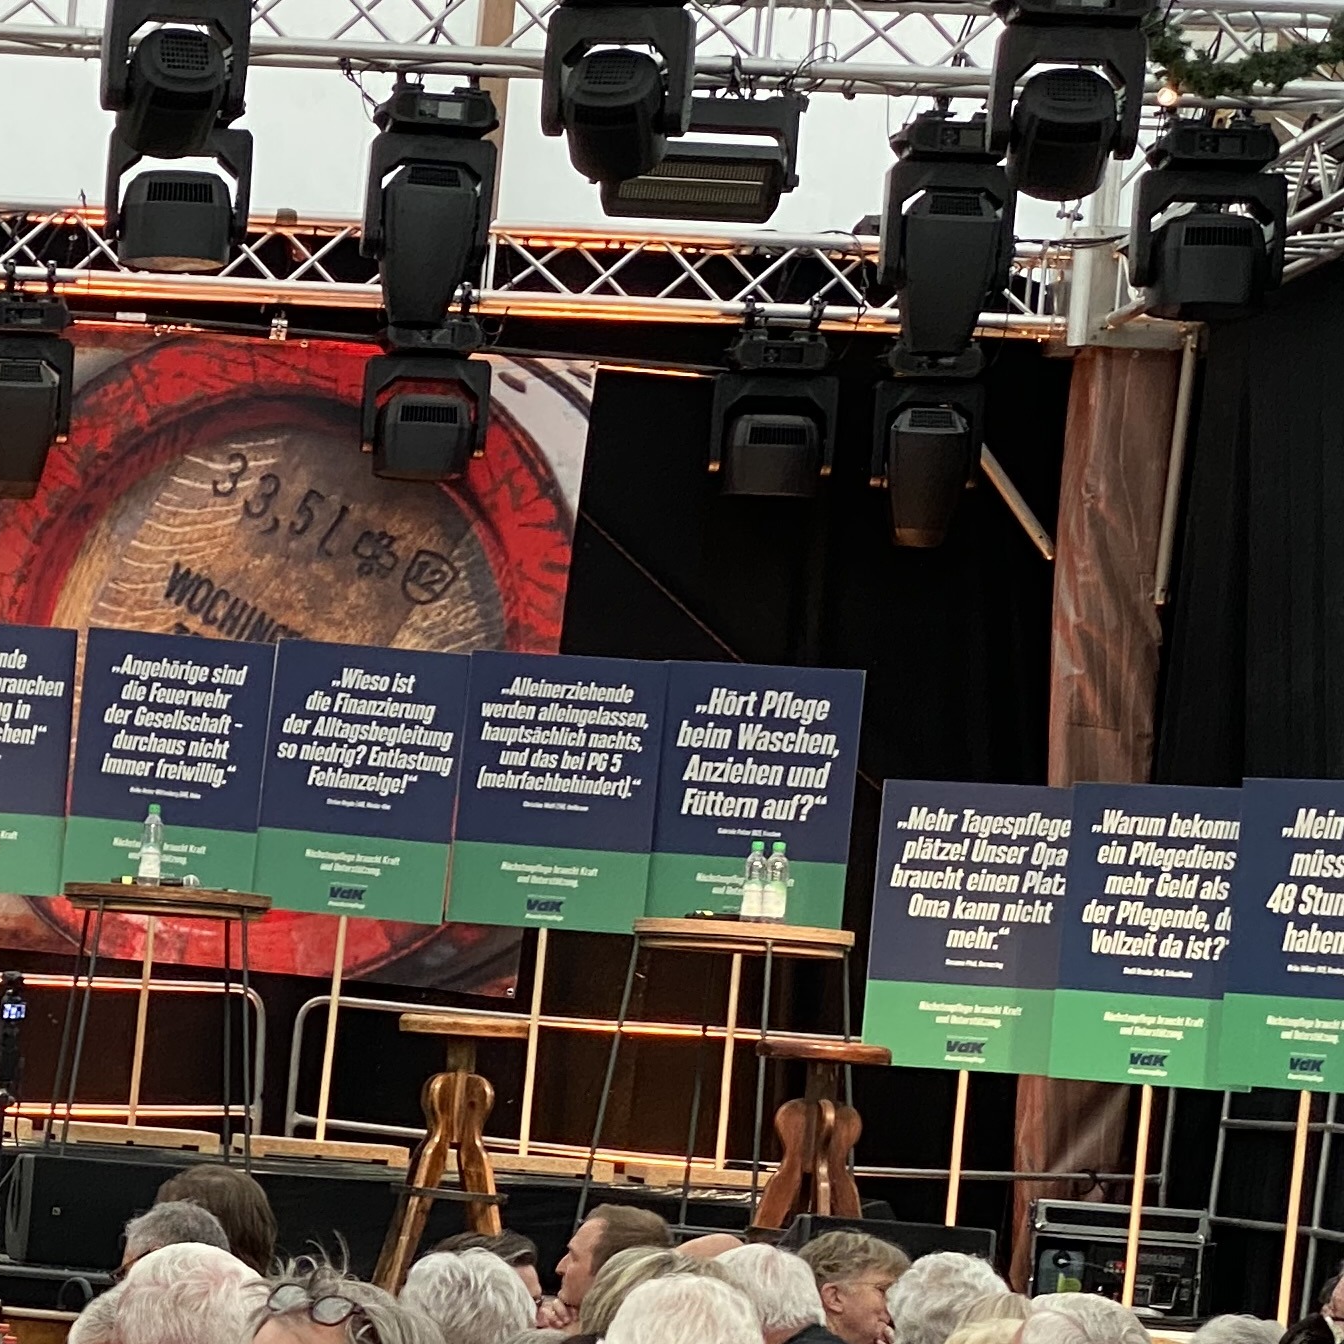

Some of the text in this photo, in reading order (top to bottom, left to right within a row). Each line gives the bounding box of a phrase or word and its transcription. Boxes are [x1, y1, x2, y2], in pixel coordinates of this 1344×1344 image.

[112, 654, 248, 686] „Angehörige sind
[331, 668, 416, 694] „Wieso ist
[121, 680, 232, 710] die Feuerwehr
[501, 676, 634, 704] „Alleinerziehende
[14, 700, 31, 720] in
[104, 703, 232, 735] der Gesellschaft
[306, 690, 436, 725] die Finanzierung
[481, 700, 649, 730] werden alleingelassen,
[695, 687, 830, 725] „Hört Pflege
[112, 729, 230, 760] durchaus nicht
[283, 714, 454, 751] der Alltagsbegleitung
[481, 722, 643, 753] hauptsächlich nachts,
[676, 720, 840, 759] beim Waschen,
[101, 753, 237, 788] immer freiwillig.“
[277, 741, 453, 777] so niedrig? Entlastung
[499, 748, 623, 773] und das bei PG 5
[682, 755, 832, 789] Anziehen und
[307, 766, 418, 796] Fehlanzeige!“
[681, 788, 827, 822] Füttern auf?“
[897, 806, 958, 832] „Mehr
[1091, 809, 1167, 836] „Warum
[902, 836, 1069, 871] plätze! Unser Opa
[1097, 840, 1126, 864] ein
[890, 863, 964, 890] braucht
[966, 869, 1020, 893] einen
[1104, 871, 1231, 900] mehr Geld als
[908, 893, 1054, 924] Oma kann nicht
[1082, 899, 1210, 933] der Pflegende,
[946, 926, 1010, 950] mehr.“
[1091, 929, 1183, 959] Vollzeit da
